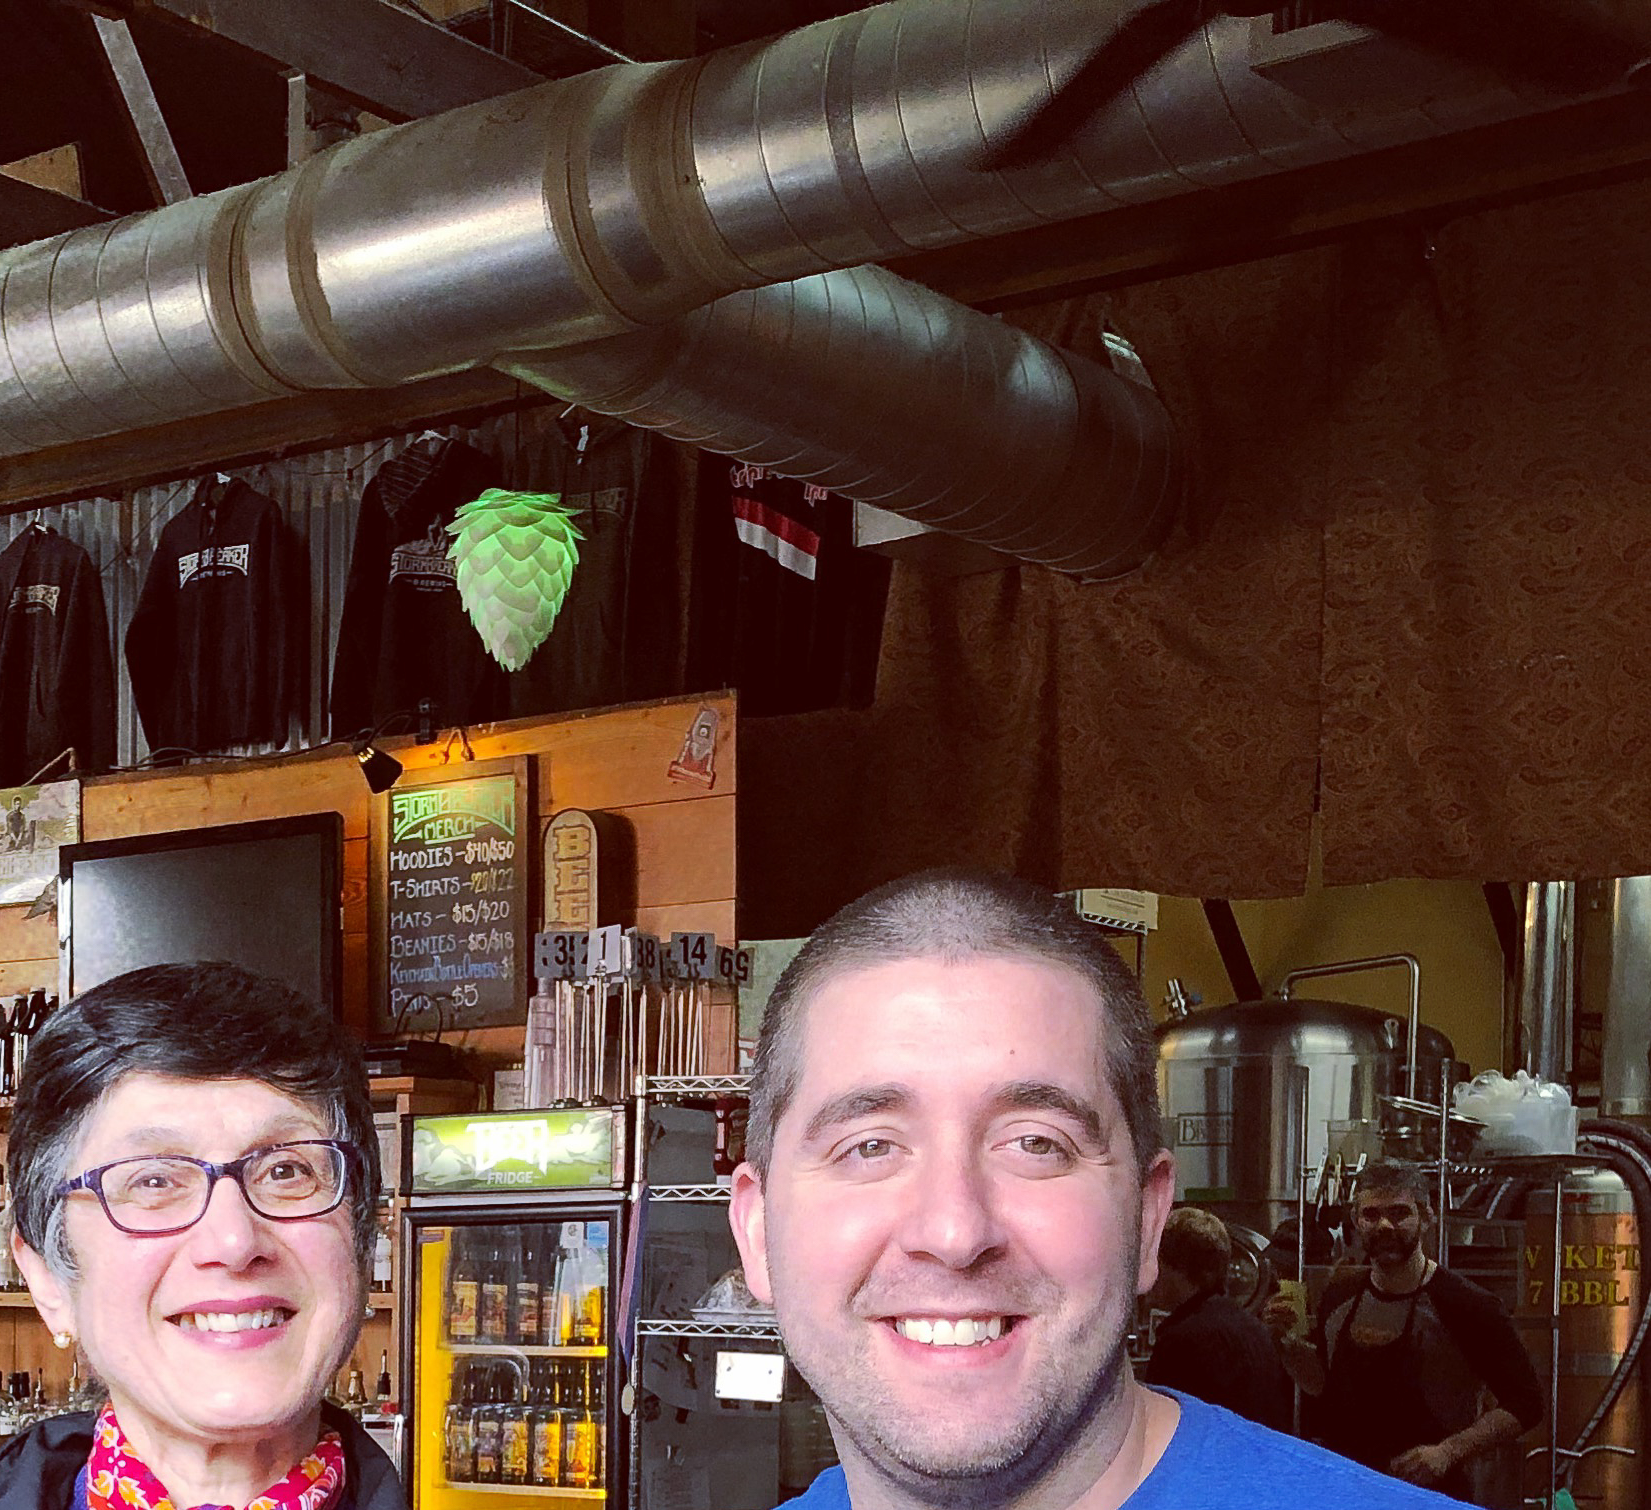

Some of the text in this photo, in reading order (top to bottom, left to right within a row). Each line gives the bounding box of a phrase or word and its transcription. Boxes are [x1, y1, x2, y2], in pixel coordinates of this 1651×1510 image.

[424, 816, 476, 840] MERCH
[390, 846, 453, 871] HOODIES
[390, 876, 460, 899] T-SHIRTS
[552, 824, 592, 930] BEE
[390, 911, 432, 930] HATS
[452, 899, 510, 926] $15/$20
[390, 934, 456, 958] BEANIES
[600, 930, 607, 961] 1
[679, 935, 708, 966] 14
[452, 983, 479, 1008] $5
[487, 1171, 533, 1184] FRIDGE
[1529, 1280, 1629, 1306] 7 BBL
